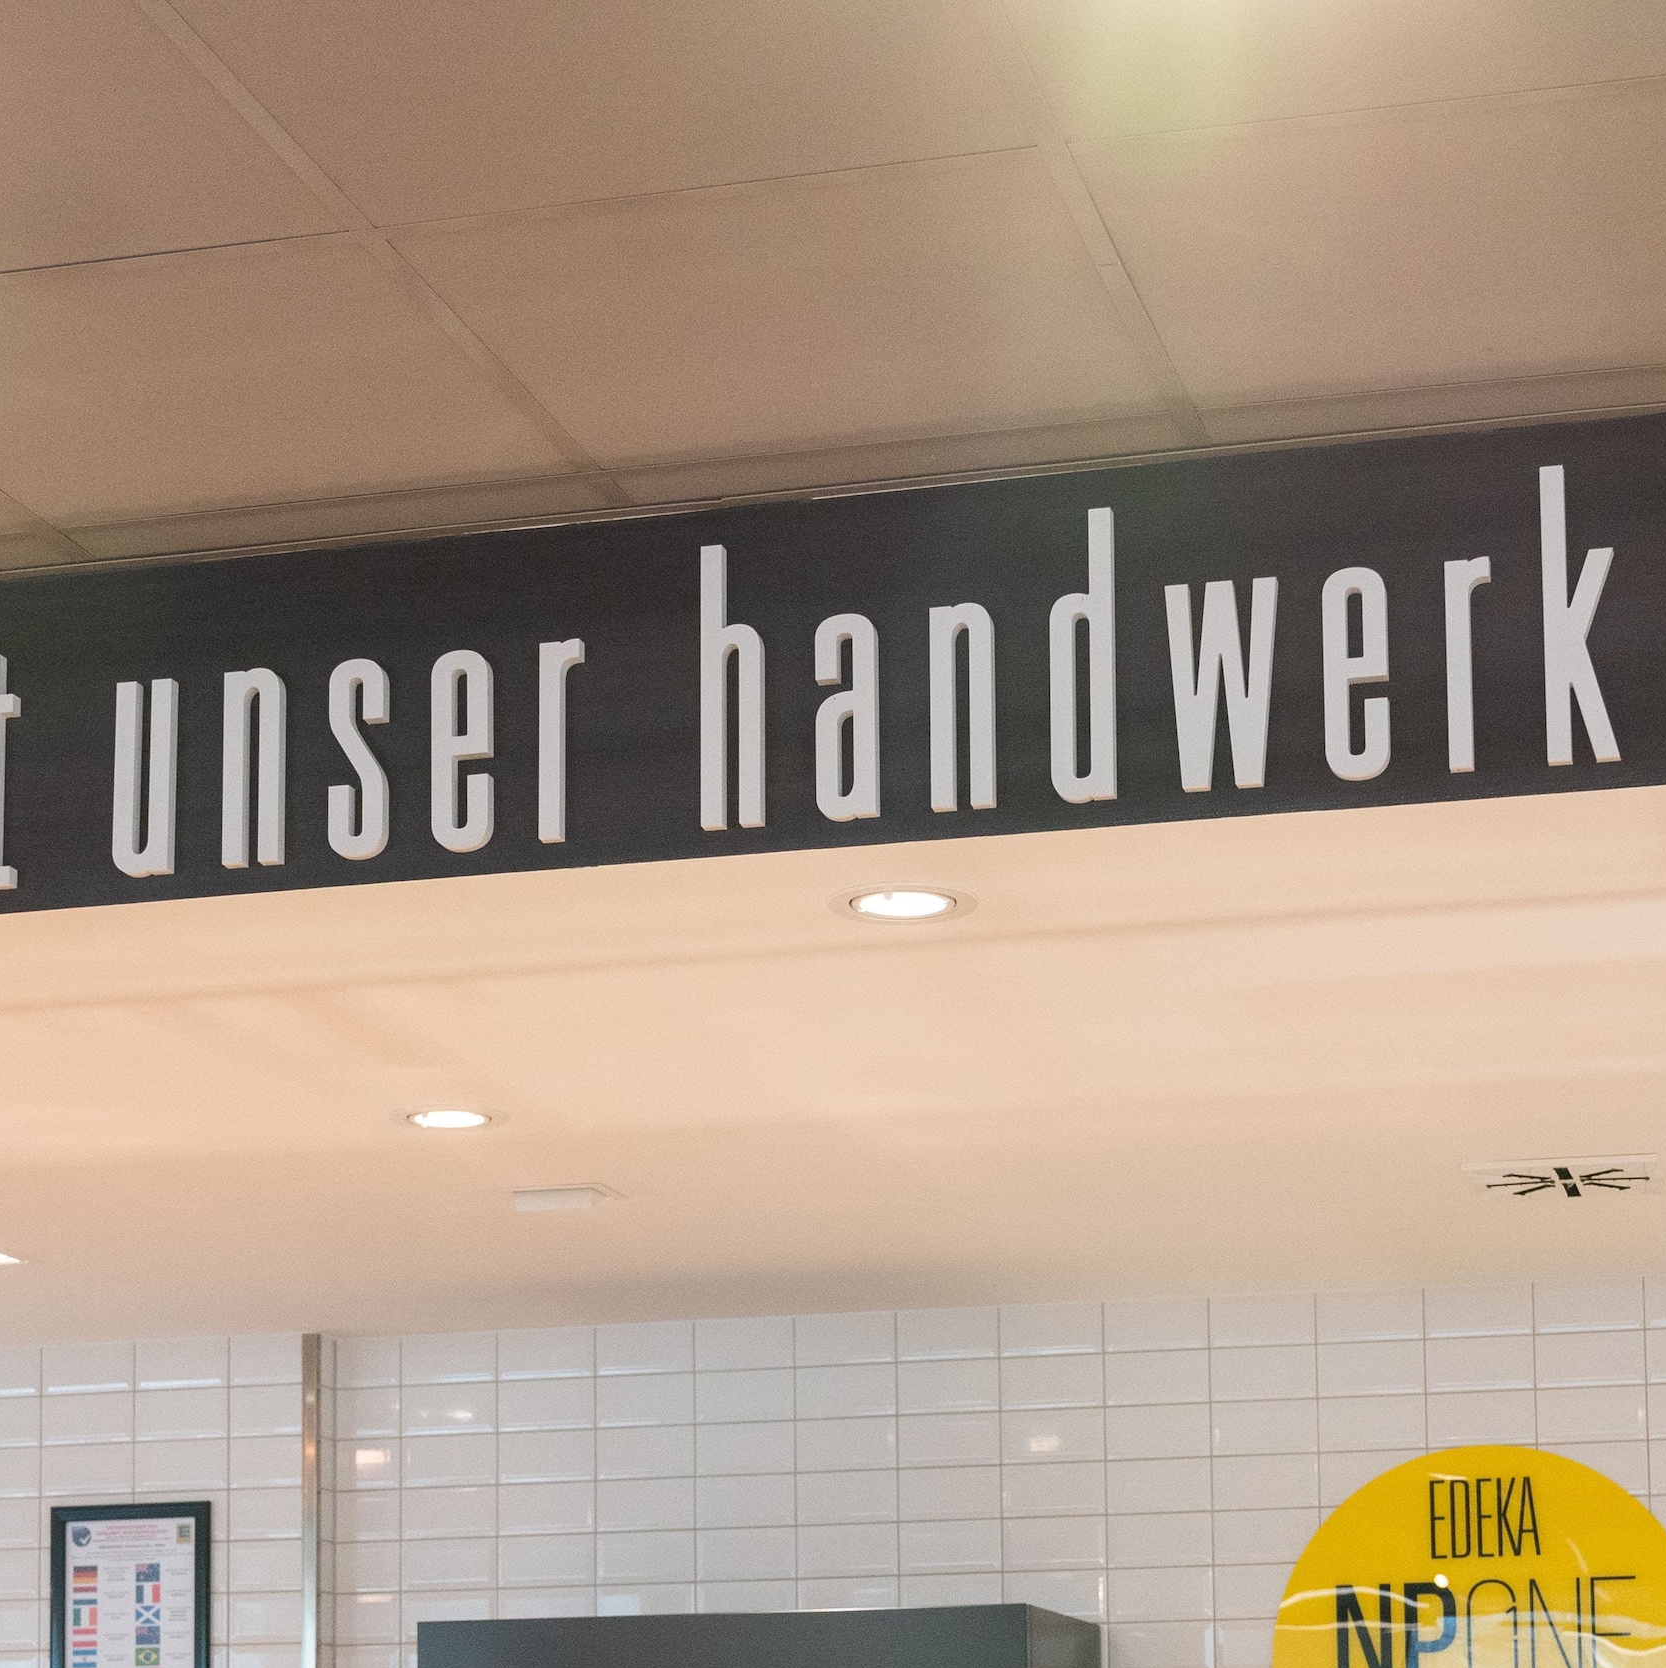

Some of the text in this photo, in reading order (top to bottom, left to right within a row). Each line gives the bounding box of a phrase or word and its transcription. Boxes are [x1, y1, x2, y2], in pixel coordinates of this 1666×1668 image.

[110, 637, 585, 878] unser
[699, 464, 1622, 832] handwerk
[1430, 1476, 1540, 1559] EDEKA
